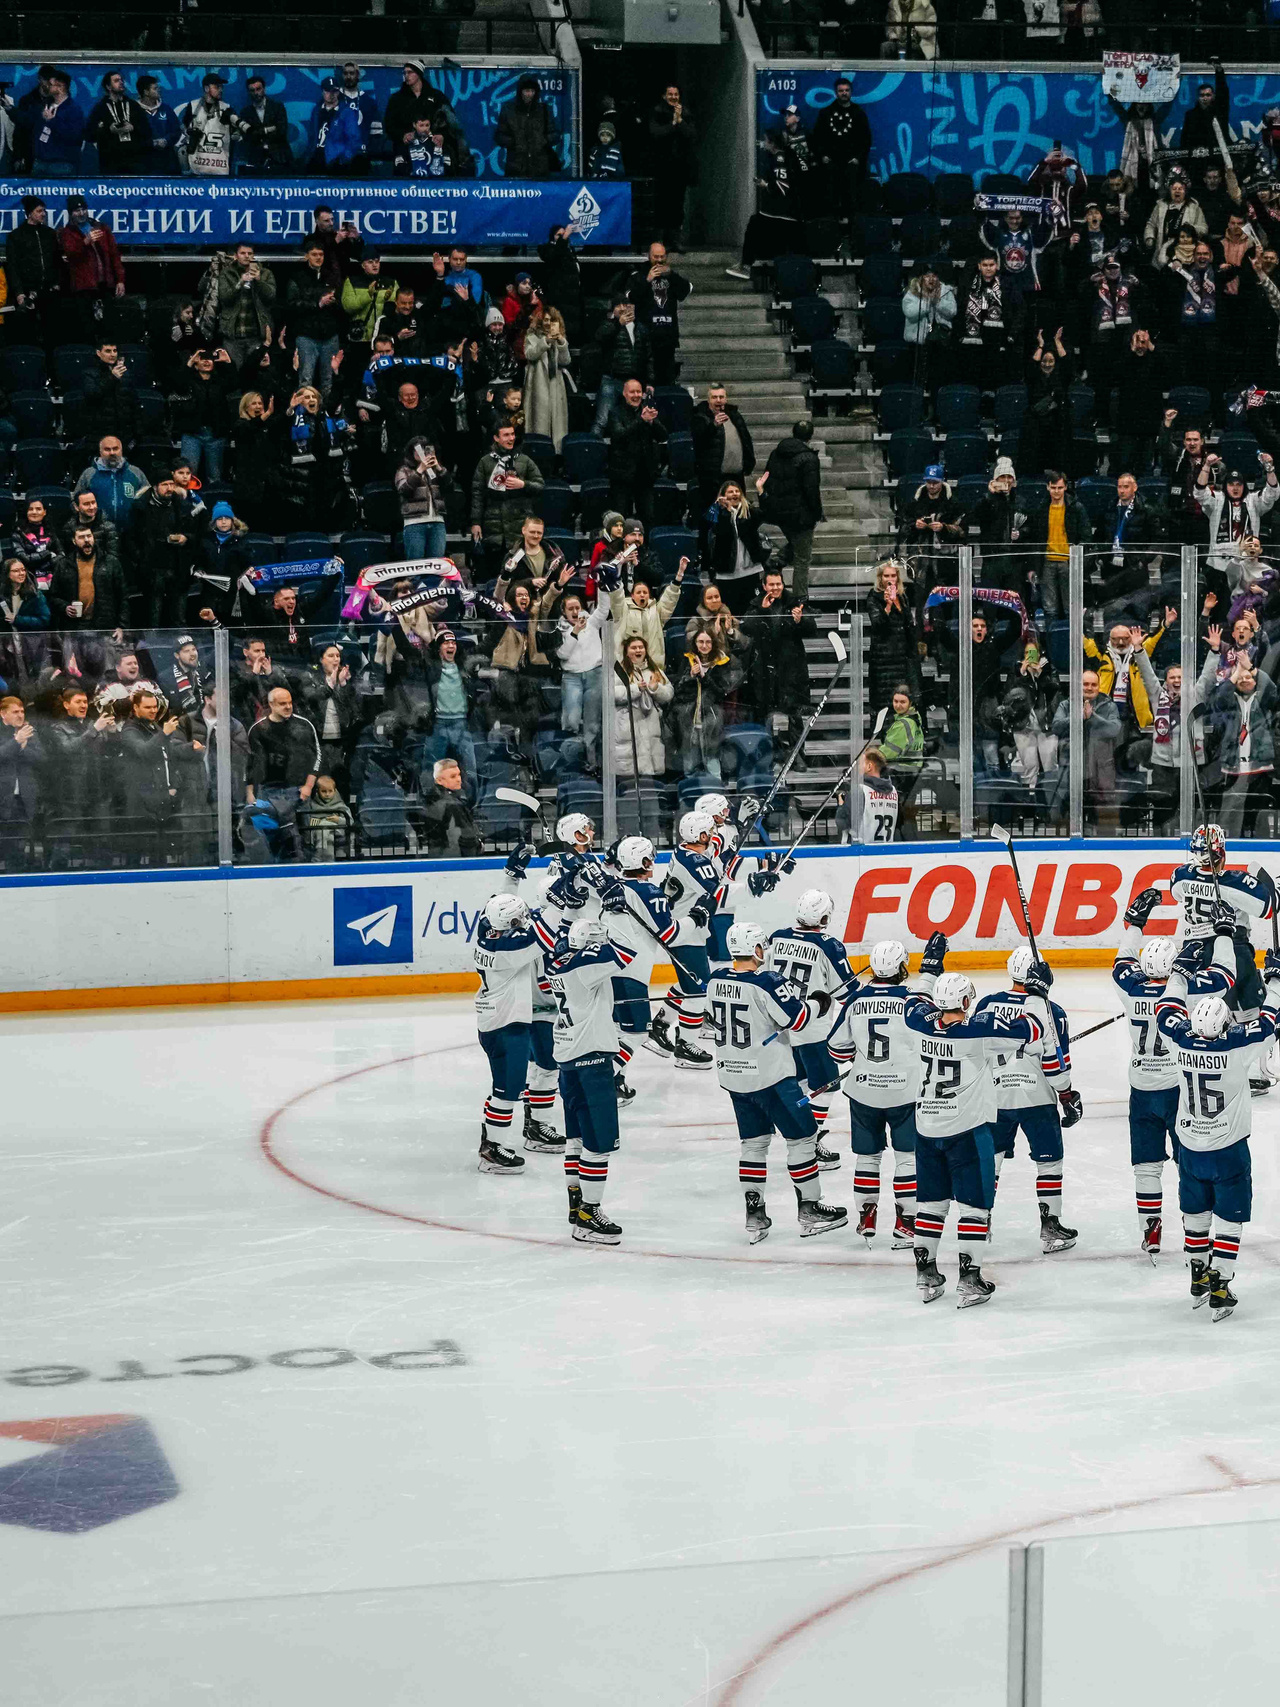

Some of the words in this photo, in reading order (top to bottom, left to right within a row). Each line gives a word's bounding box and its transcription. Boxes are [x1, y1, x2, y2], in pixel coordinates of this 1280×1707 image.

[768, 79, 799, 92] A103
[89, 183, 205, 199] «Всероссийское
[208, 182, 398, 202] физкультурно-спортивное
[401, 184, 468, 201] общество
[471, 184, 543, 201] «Динамо»
[0, 208, 213, 234] ДИЕНИИ
[228, 208, 255, 234] И
[873, 814, 894, 842] 23
[696, 864, 716, 883] 10
[649, 897, 669, 914] 77
[422, 900, 482, 944] /dy
[715, 982, 743, 1000] MARIN
[852, 1000, 905, 1016] KONYUSHKO
[867, 1017, 891, 1064] 6
[920, 1039, 954, 1058] BOKUN
[1177, 1050, 1228, 1070] ATANASOV
[1181, 1070, 1225, 1119] 16
